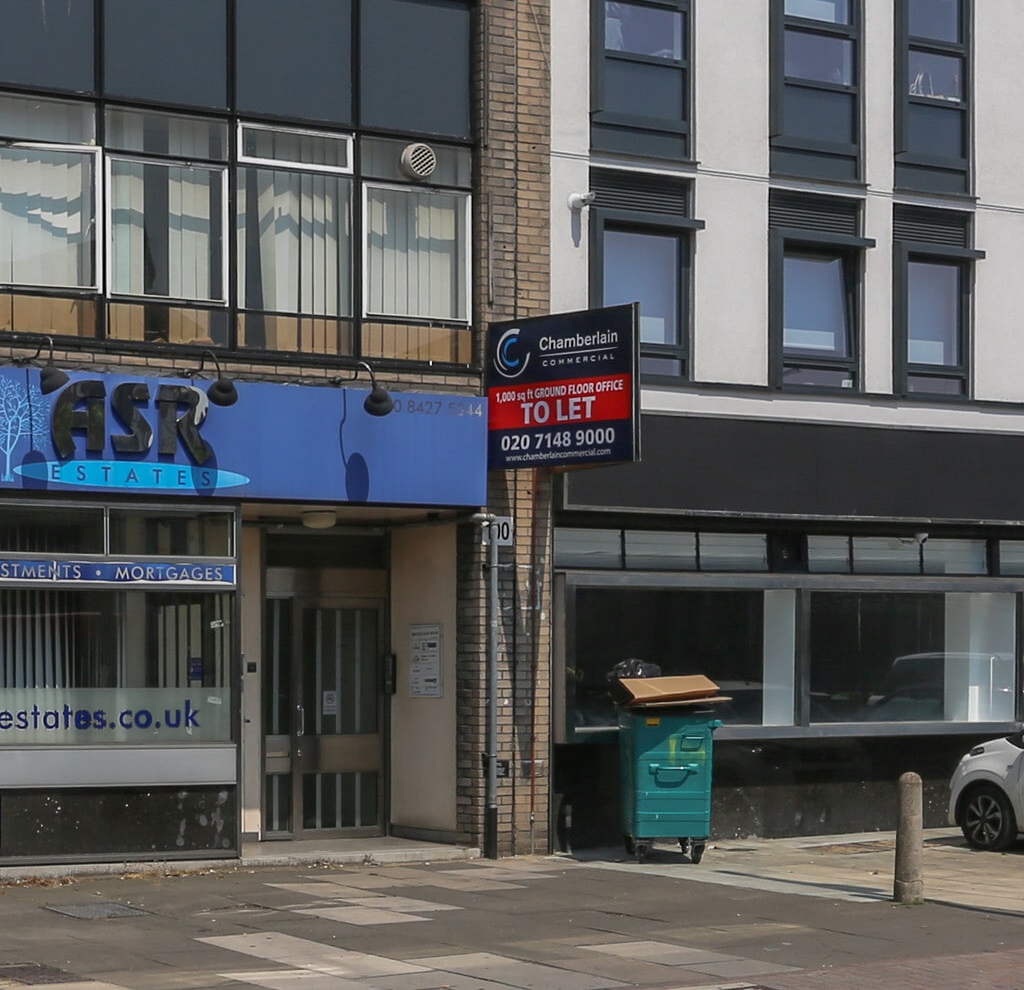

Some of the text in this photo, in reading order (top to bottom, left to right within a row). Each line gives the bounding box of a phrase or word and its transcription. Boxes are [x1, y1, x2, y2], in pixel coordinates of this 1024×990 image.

[539, 329, 618, 351] Chamberlain
[542, 353, 615, 367] COMMERCIAL
[496, 379, 623, 403] 1,000 sq ft GROUND FLOOR OFFICE
[407, 400, 442, 415] 8427
[521, 396, 596, 425] TO LET
[53, 380, 213, 465] ASR
[501, 427, 616, 451] 020 7148 9000
[505, 448, 611, 462] www.chamberlaincommercial.com
[52, 463, 211, 487] ESTATES
[115, 566, 223, 581] MORTGAGES
